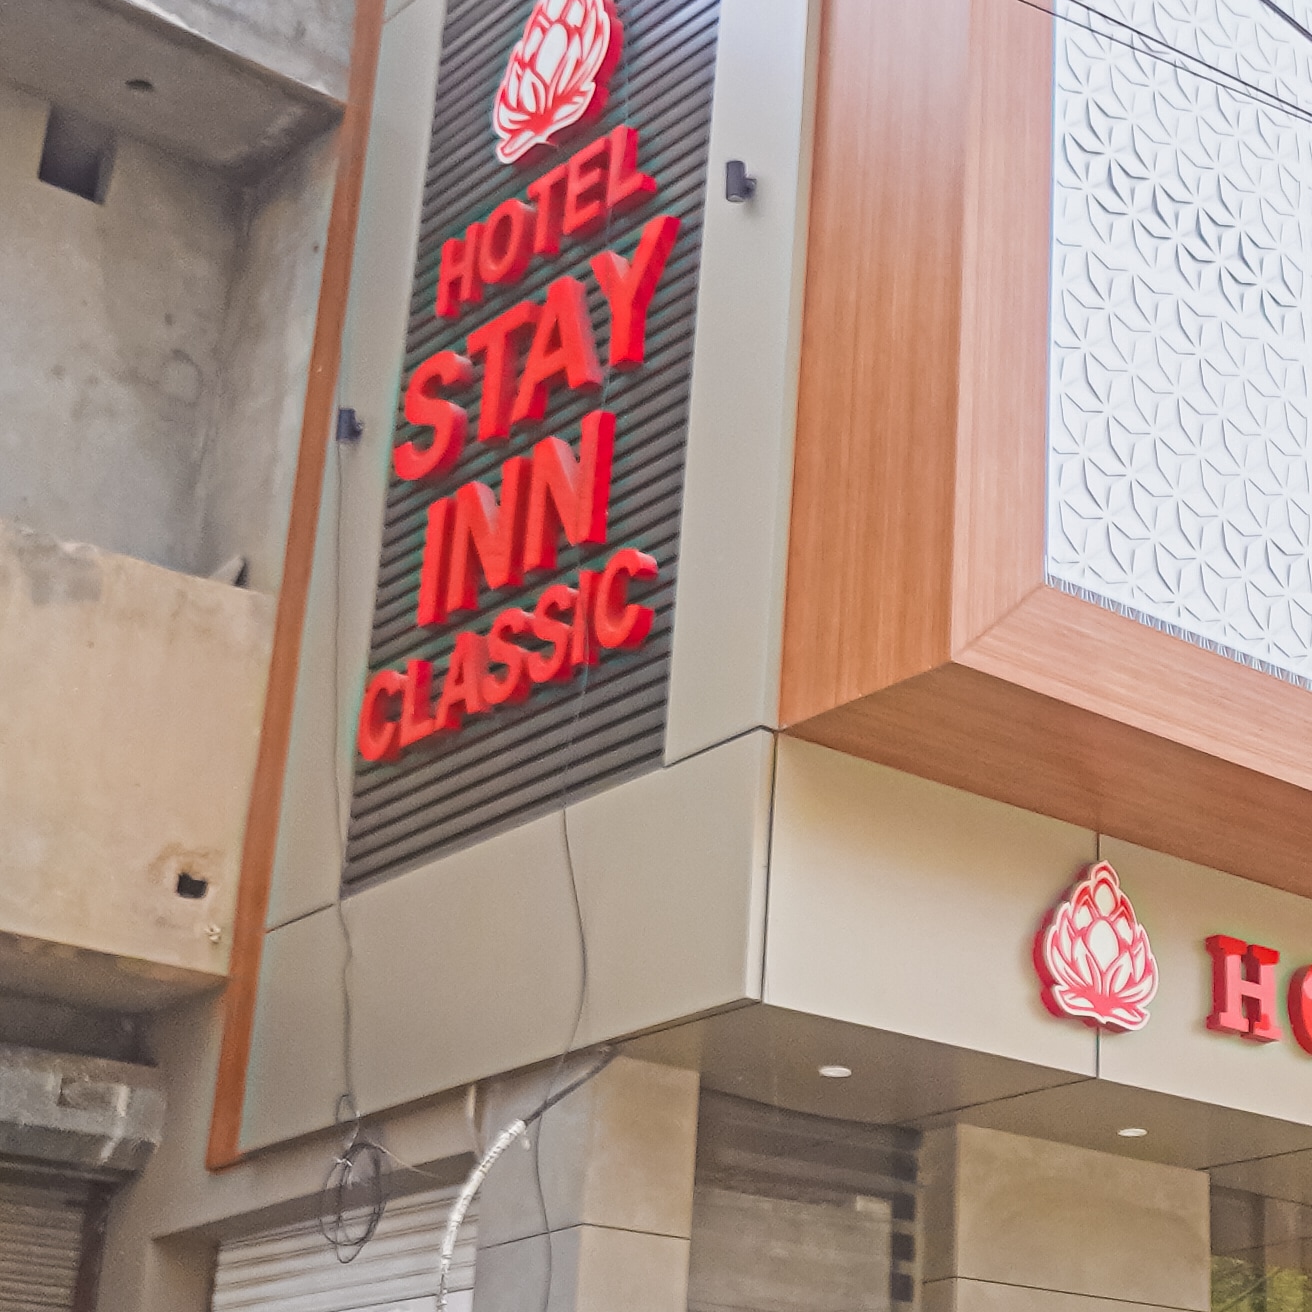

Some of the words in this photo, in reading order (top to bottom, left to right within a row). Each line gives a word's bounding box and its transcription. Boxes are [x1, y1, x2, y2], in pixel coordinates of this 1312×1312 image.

[435, 126, 657, 318] HOTEL
[394, 216, 681, 482] STAY
[417, 411, 616, 626] INN
[356, 548, 658, 761] CLASSIC
